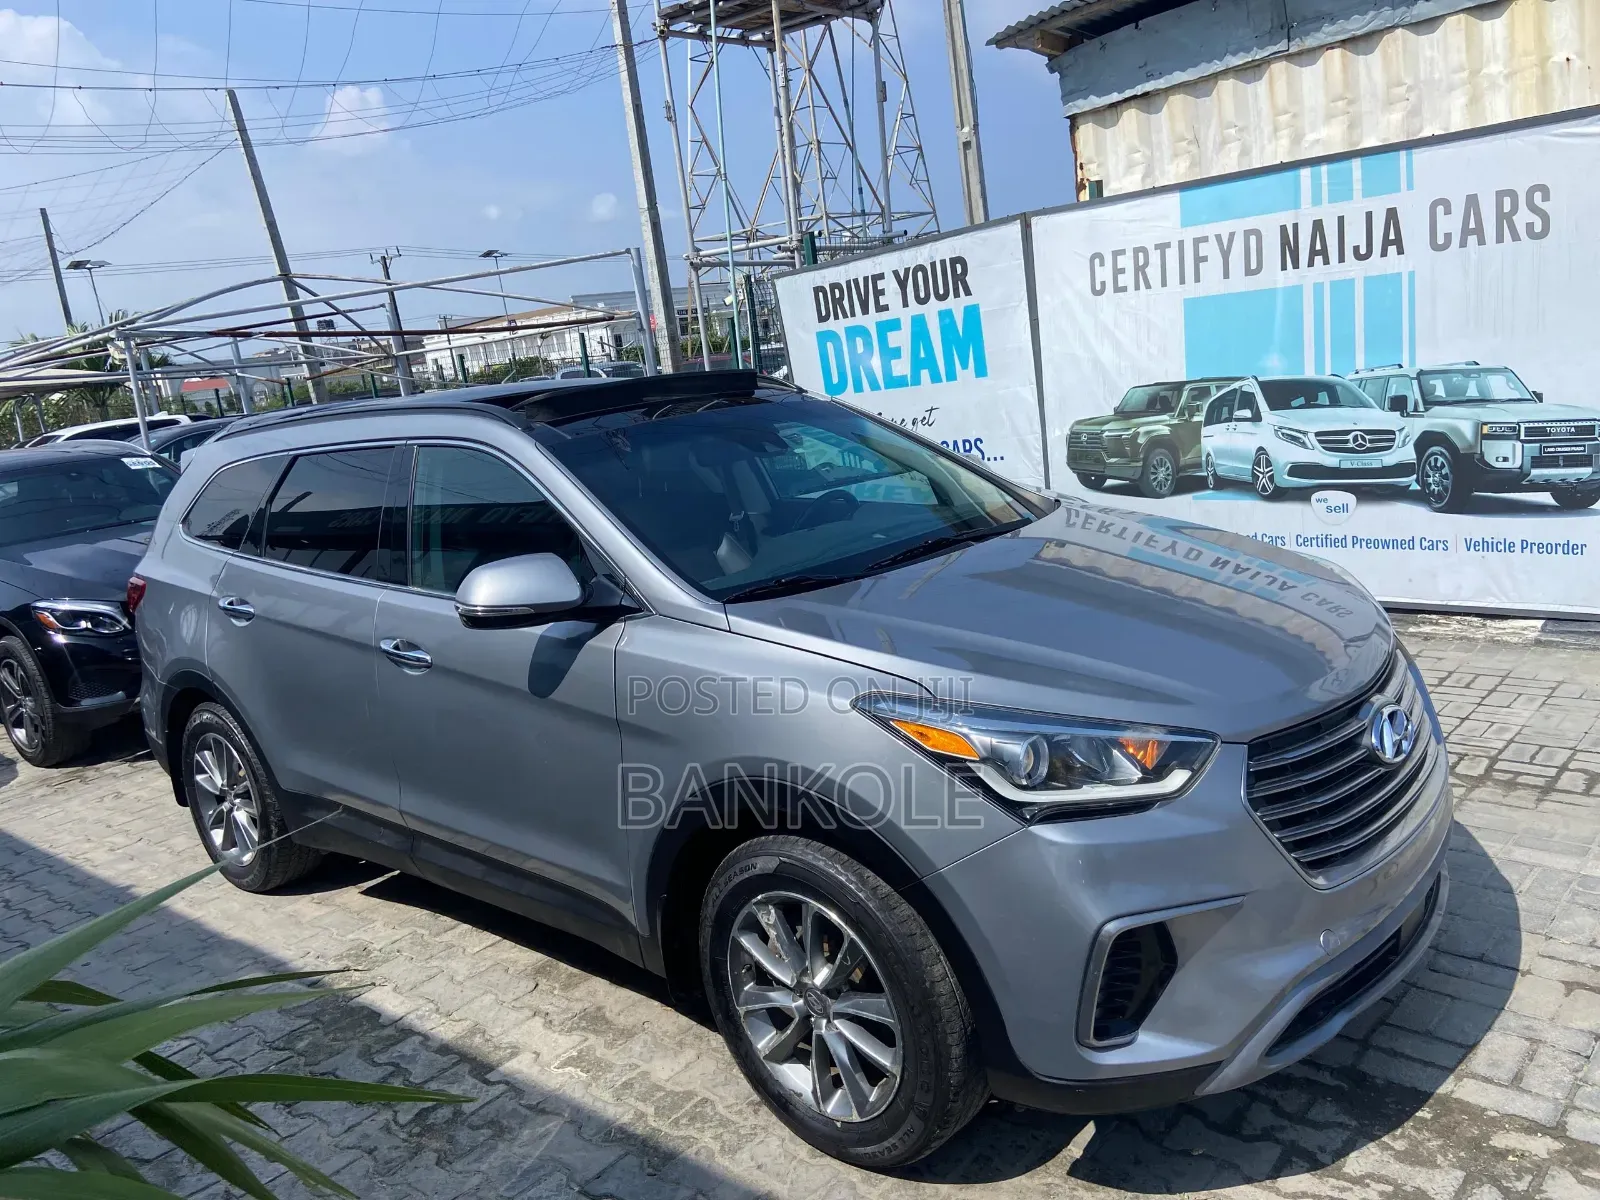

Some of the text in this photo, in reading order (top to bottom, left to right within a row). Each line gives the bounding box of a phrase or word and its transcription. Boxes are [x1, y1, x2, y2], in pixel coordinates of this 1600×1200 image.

[1089, 183, 1551, 297] CERTIFYD NAIJA CARS
[813, 255, 973, 323] DRIVE YOUR
[816, 303, 988, 397] DREAM
[911, 405, 940, 431] get
[1326, 503, 1349, 514] sell
[1261, 533, 1286, 547] Cars
[1295, 534, 1449, 552] Certified Preowned Cars
[1464, 537, 1587, 556] Vehicle Preorder
